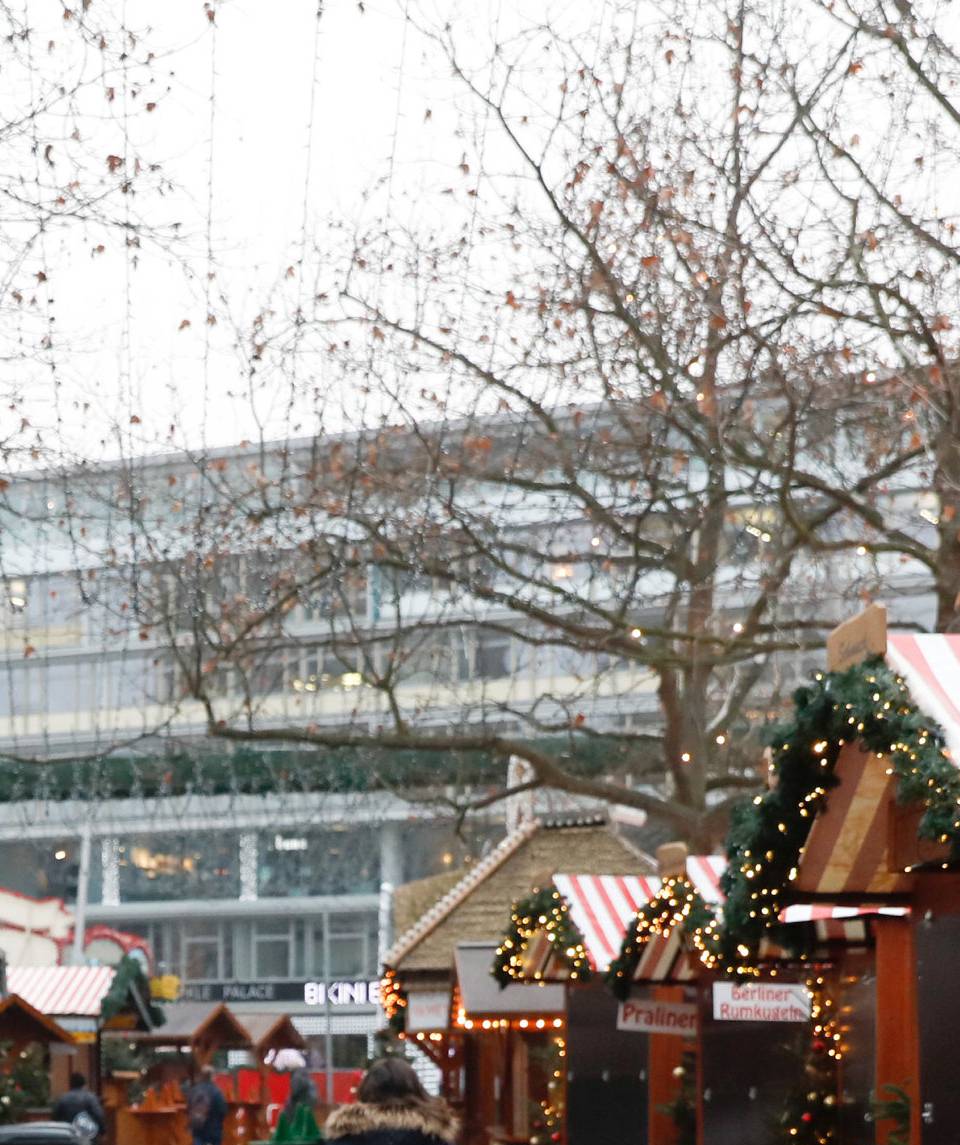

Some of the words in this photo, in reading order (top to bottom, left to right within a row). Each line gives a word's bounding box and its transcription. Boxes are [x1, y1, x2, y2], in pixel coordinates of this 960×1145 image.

[304, 981, 367, 1005] BIKINI
[731, 985, 792, 1000] Berliner
[719, 1003, 800, 1020] Rumkugeln
